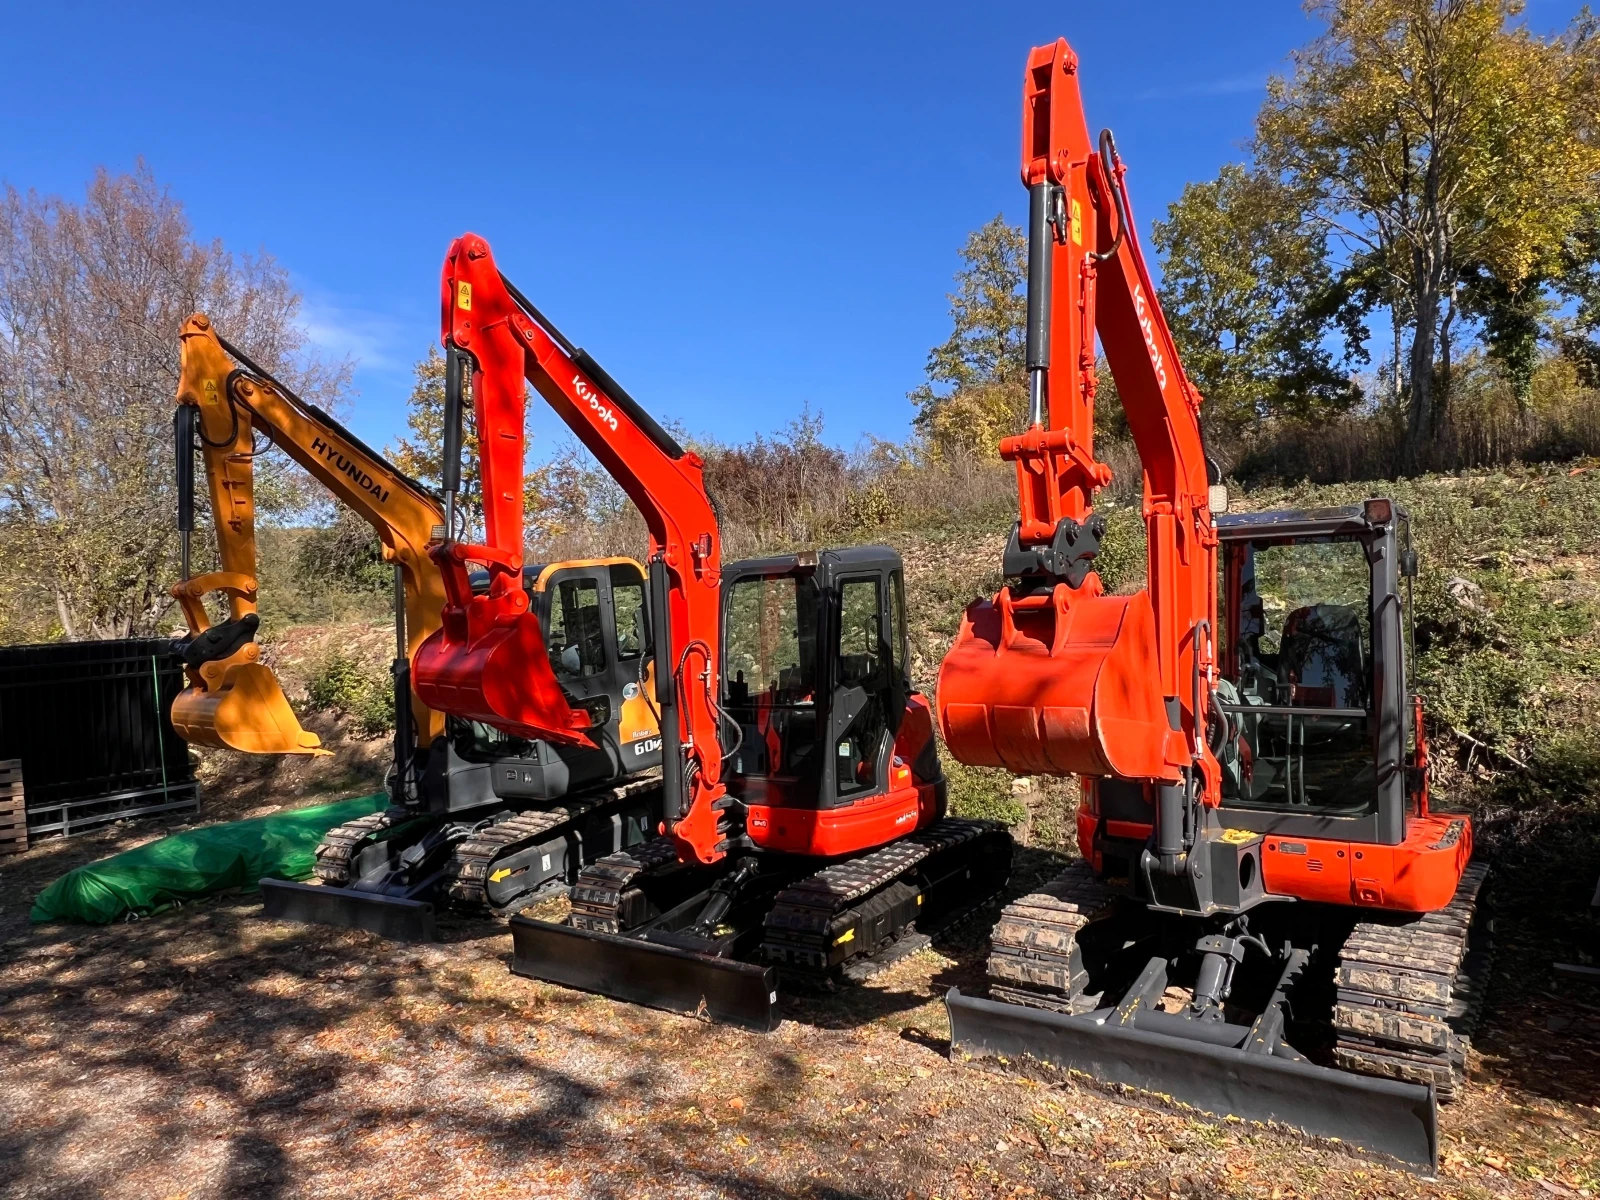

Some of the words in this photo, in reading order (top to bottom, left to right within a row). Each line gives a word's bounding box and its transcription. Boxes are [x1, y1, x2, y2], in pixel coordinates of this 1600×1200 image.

[1134, 284, 1167, 390] Kubota
[572, 375, 618, 431] Kubota
[311, 437, 389, 503] HYUNDAI
